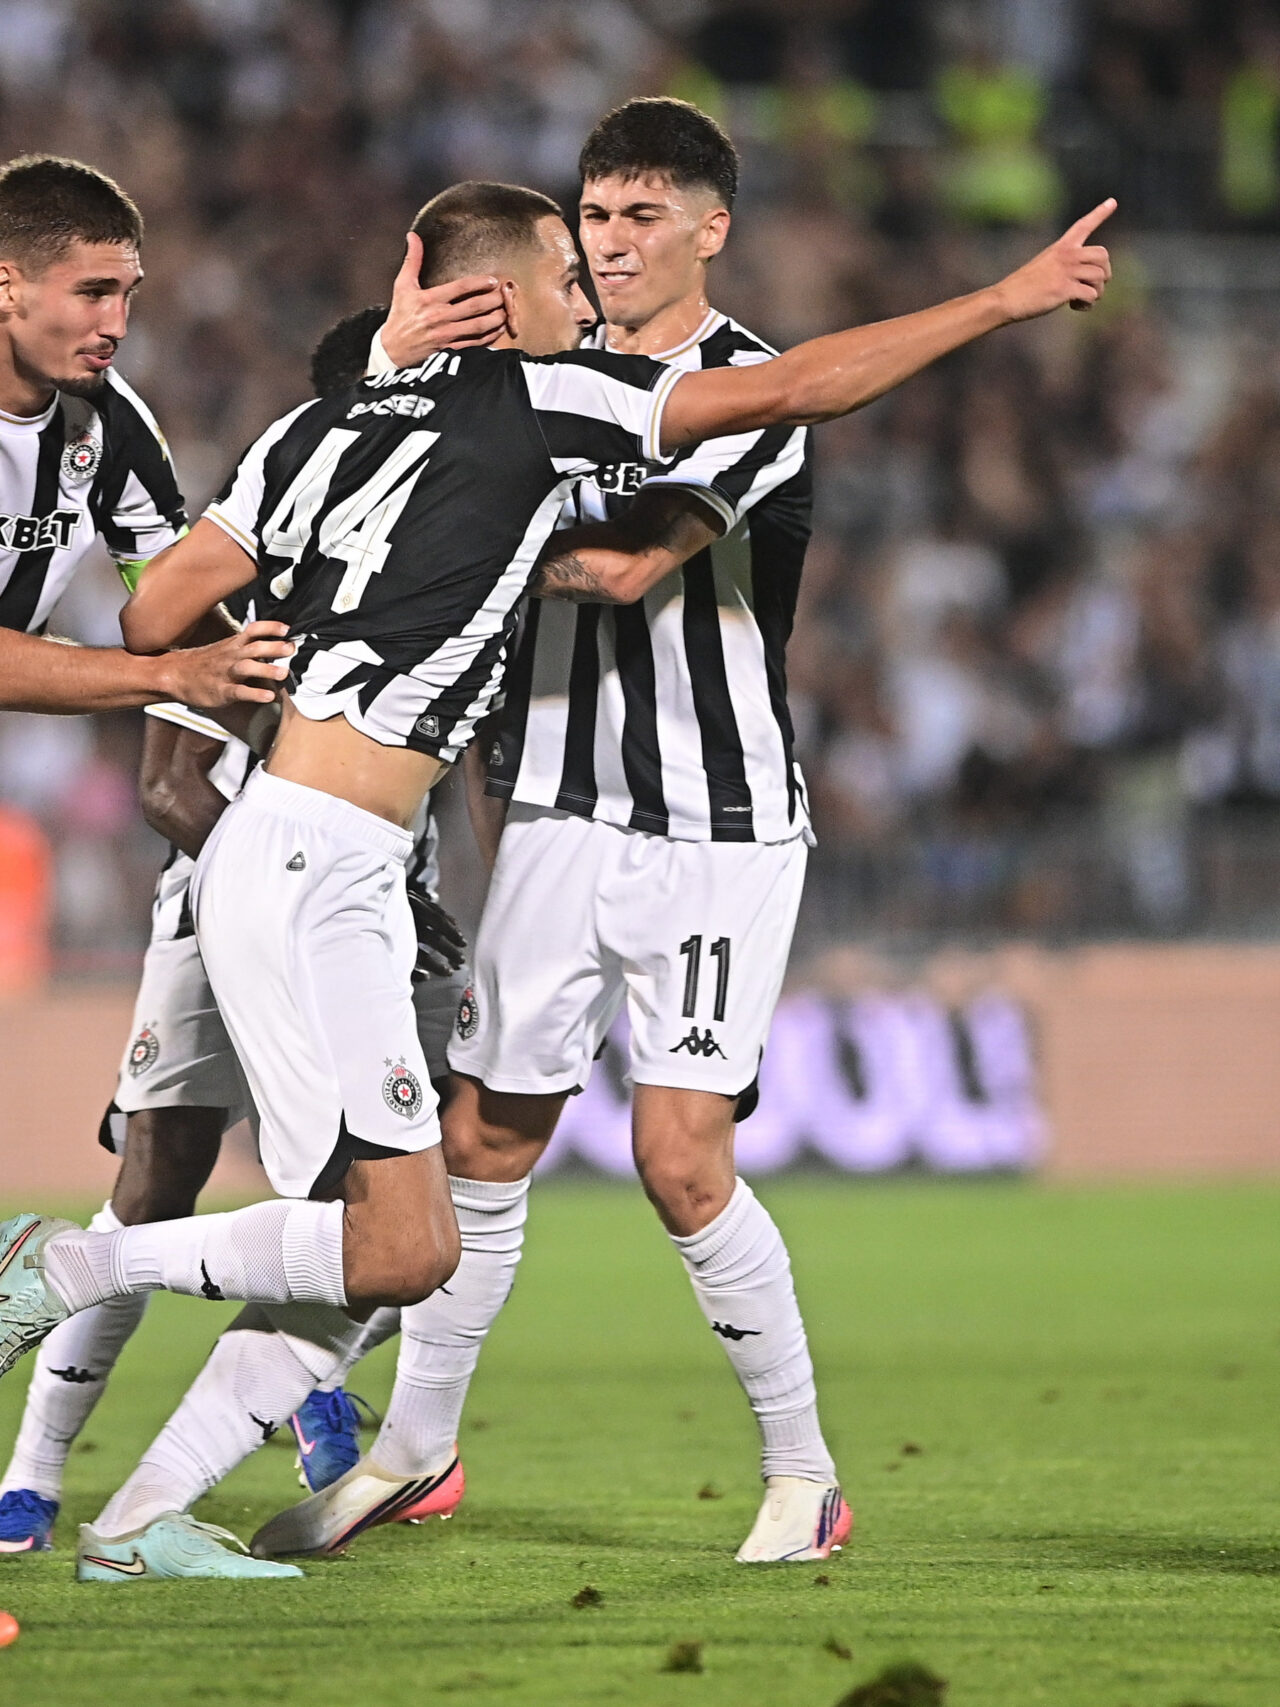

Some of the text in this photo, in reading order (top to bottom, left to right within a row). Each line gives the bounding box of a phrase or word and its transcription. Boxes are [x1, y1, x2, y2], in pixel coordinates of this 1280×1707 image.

[261, 427, 441, 615] 44
[593, 462, 647, 496] BE
[680, 935, 731, 1022] 11
